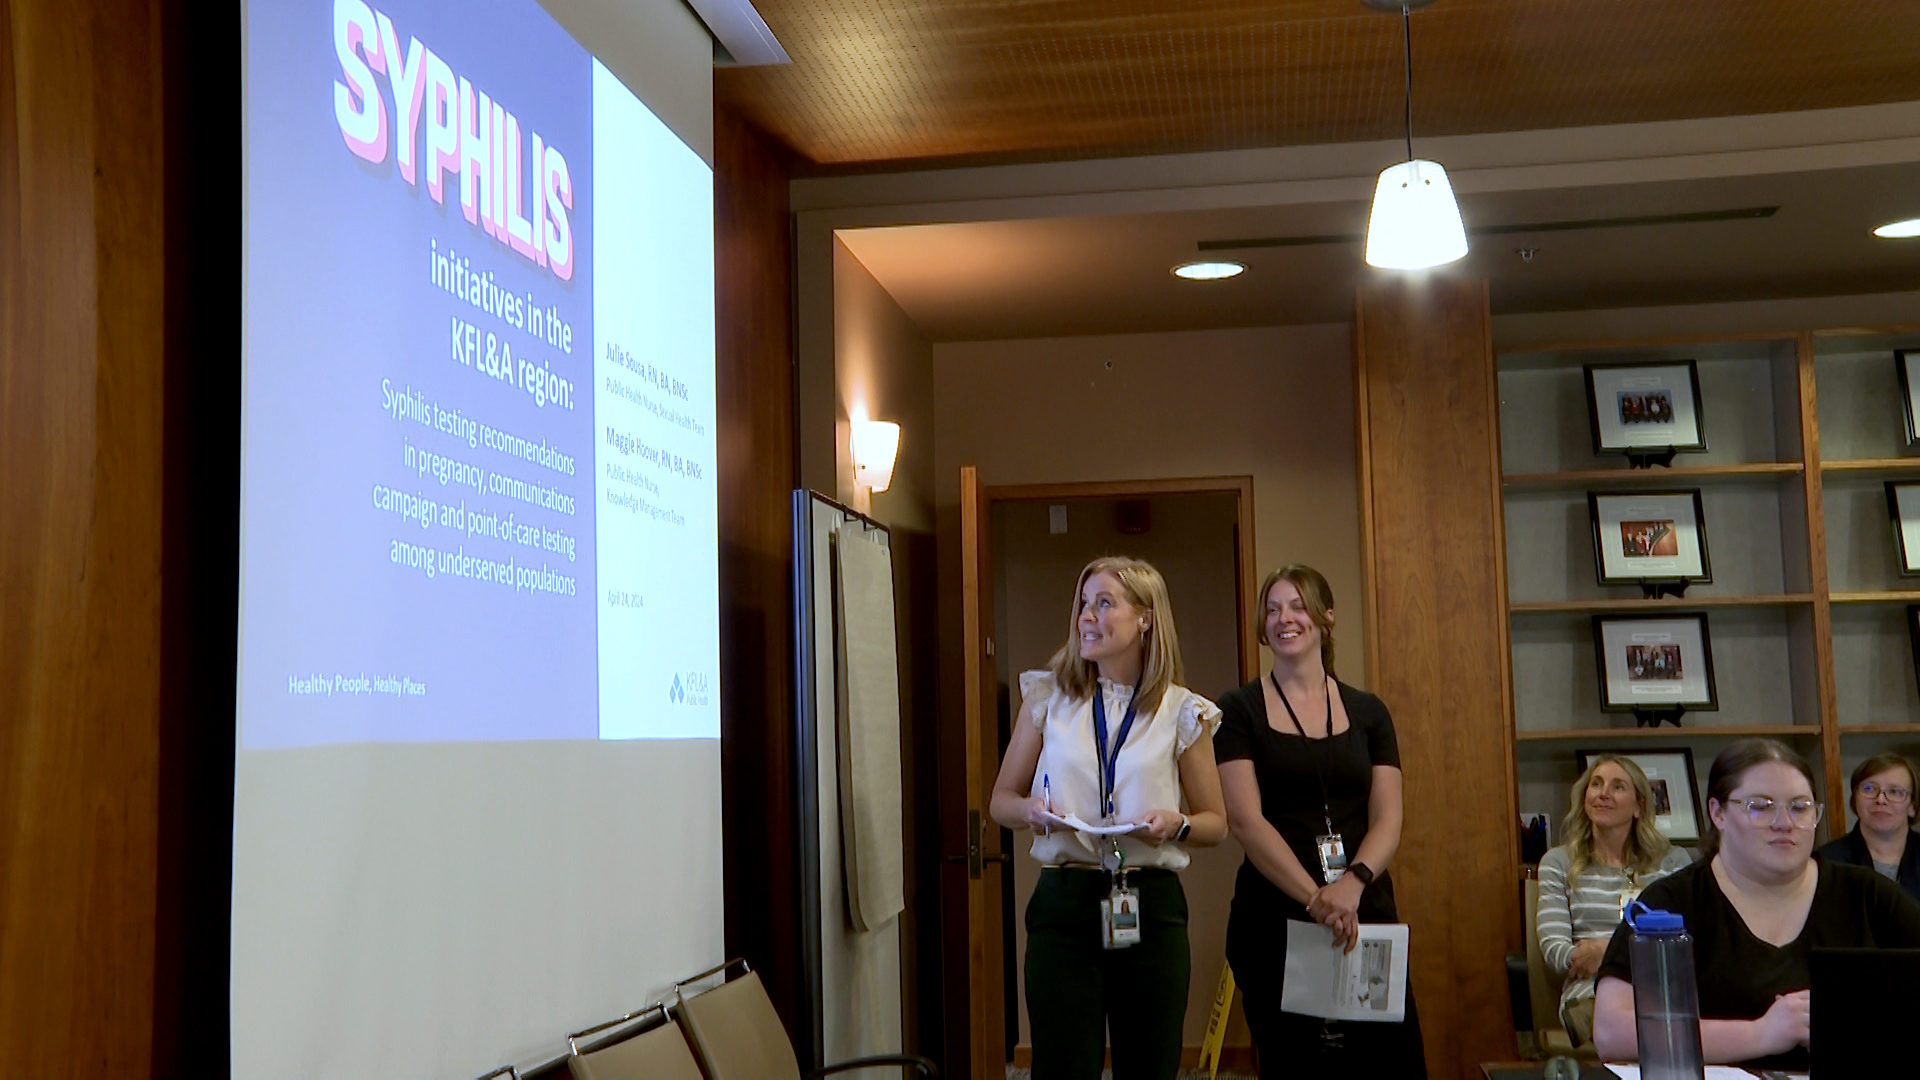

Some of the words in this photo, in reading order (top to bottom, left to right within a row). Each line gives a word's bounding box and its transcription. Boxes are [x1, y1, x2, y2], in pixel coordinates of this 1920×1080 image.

[332, 0, 574, 282] SYPHILIS
[430, 237, 524, 329] initiatives
[527, 292, 543, 340] in
[546, 305, 572, 354] the
[451, 316, 514, 385] KFL&A
[517, 357, 574, 411] region:
[606, 341, 624, 366] Julie
[648, 364, 659, 390] RN,
[660, 371, 671, 396] BA,
[606, 376, 625, 398] Public
[625, 384, 643, 408] Health
[381, 377, 431, 422] Syphilis
[433, 401, 477, 449] testing
[479, 422, 575, 476] recommendations
[606, 425, 635, 455] Maggie
[661, 449, 673, 474] RN,
[404, 435, 416, 468] in
[418, 447, 488, 496] pregnancy,
[489, 470, 575, 516] communications
[606, 463, 626, 482] Public
[626, 469, 643, 489] Health
[606, 488, 639, 513] Knowledge
[372, 484, 438, 529] campaign
[440, 499, 465, 531] and
[467, 508, 541, 548] point-of-care
[542, 524, 576, 563] testing
[390, 538, 436, 579] among
[438, 544, 514, 586] underserved
[516, 562, 576, 597] populations
[607, 589, 620, 608] April
[288, 672, 333, 698] Healthy
[335, 671, 373, 696] People,
[373, 673, 402, 698] Healthy
[403, 675, 427, 696] Places
